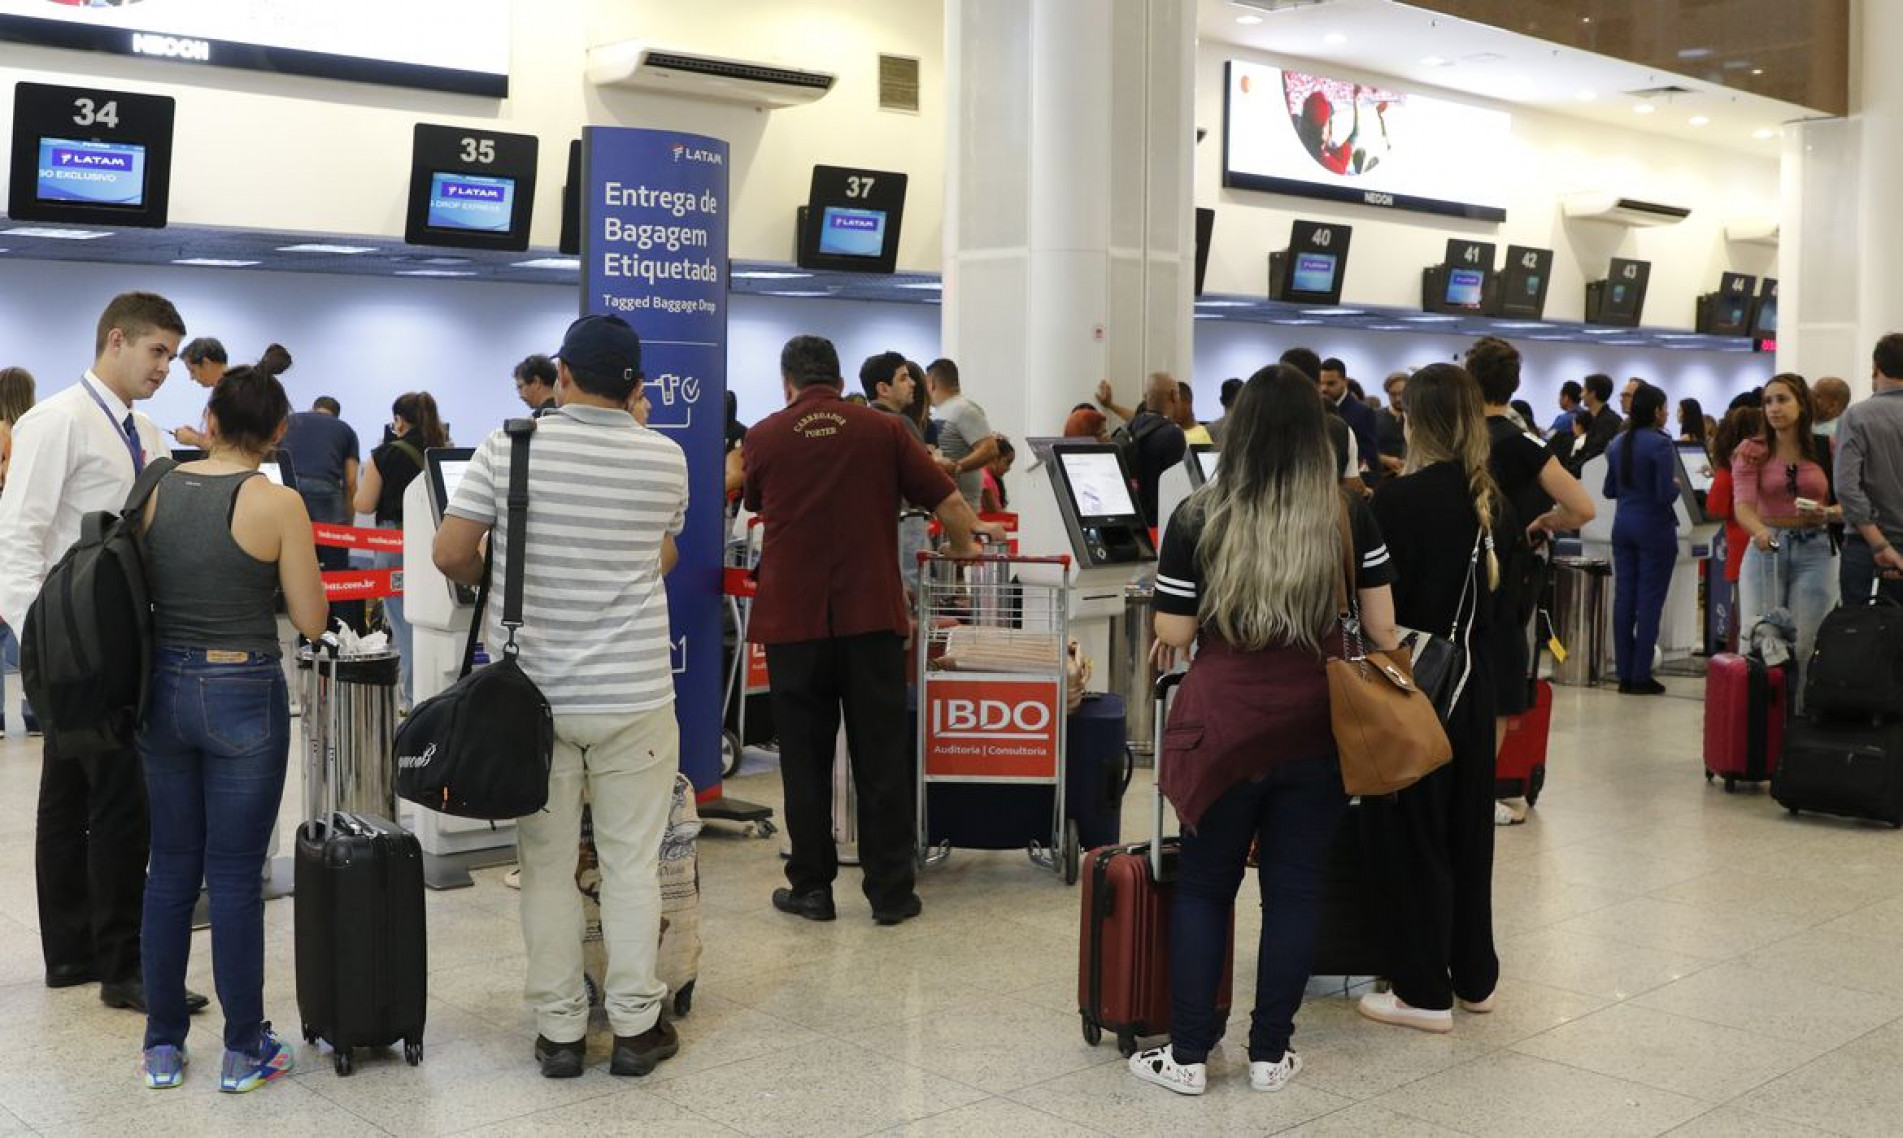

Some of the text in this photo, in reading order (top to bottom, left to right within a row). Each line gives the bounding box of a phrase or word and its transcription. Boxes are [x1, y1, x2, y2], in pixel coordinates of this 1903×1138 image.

[73, 98, 119, 128] 34
[460, 138, 495, 164] 35
[686, 148, 722, 165] LATAM
[74, 155, 125, 166] LATAM
[56, 170, 117, 182] EXCLUSIVO
[458, 186, 498, 198] LATAM
[846, 176, 875, 198] 37
[605, 182, 717, 217] Entrega de
[604, 217, 707, 251] Bagagem
[1311, 228, 1332, 247] 40
[1464, 246, 1480, 263] 41
[1522, 252, 1538, 268] 42
[604, 253, 717, 285] Etiquetada
[1623, 264, 1638, 279] 43
[603, 294, 716, 315] Tagged Baggage Drop
[934, 745, 1047, 756] Auditoria Consultoria
